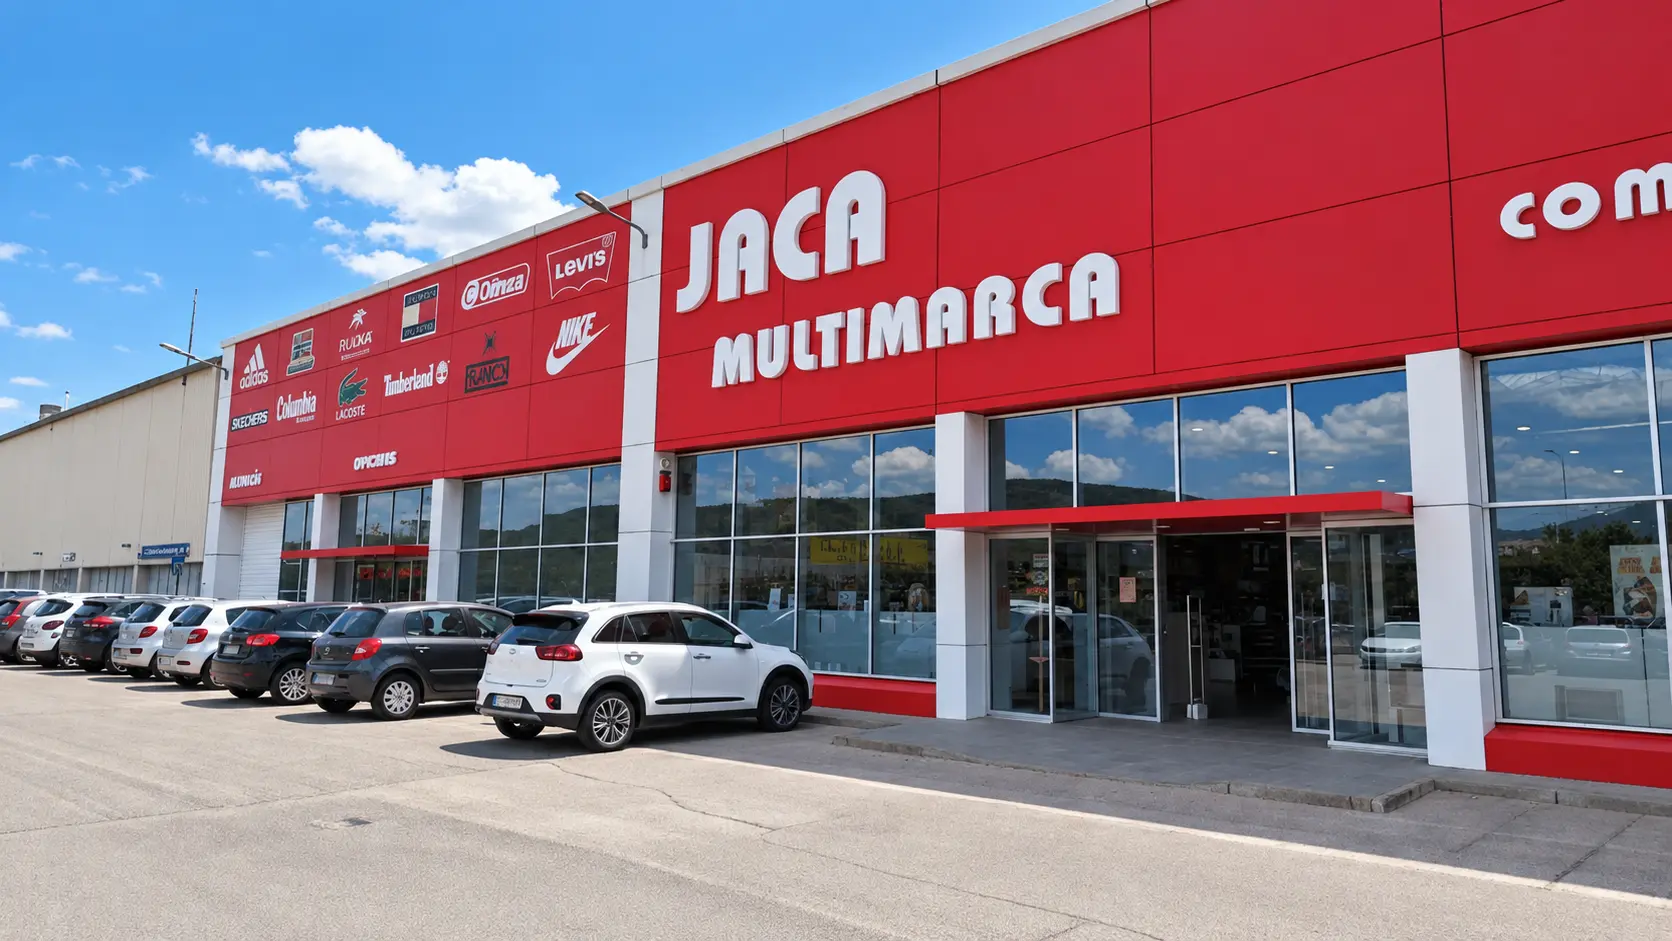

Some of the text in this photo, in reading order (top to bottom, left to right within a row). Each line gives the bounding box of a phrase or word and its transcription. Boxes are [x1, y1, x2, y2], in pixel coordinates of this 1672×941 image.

[675, 169, 887, 314] JACA
[554, 311, 597, 350] NIKE
[711, 252, 1120, 388] MULTIMARCA
[239, 369, 269, 390] adidas
[384, 363, 434, 397] Timberland
[231, 410, 269, 431] SKECHERS
[276, 390, 317, 421] Columbia
[335, 404, 366, 421] LACOSTE
